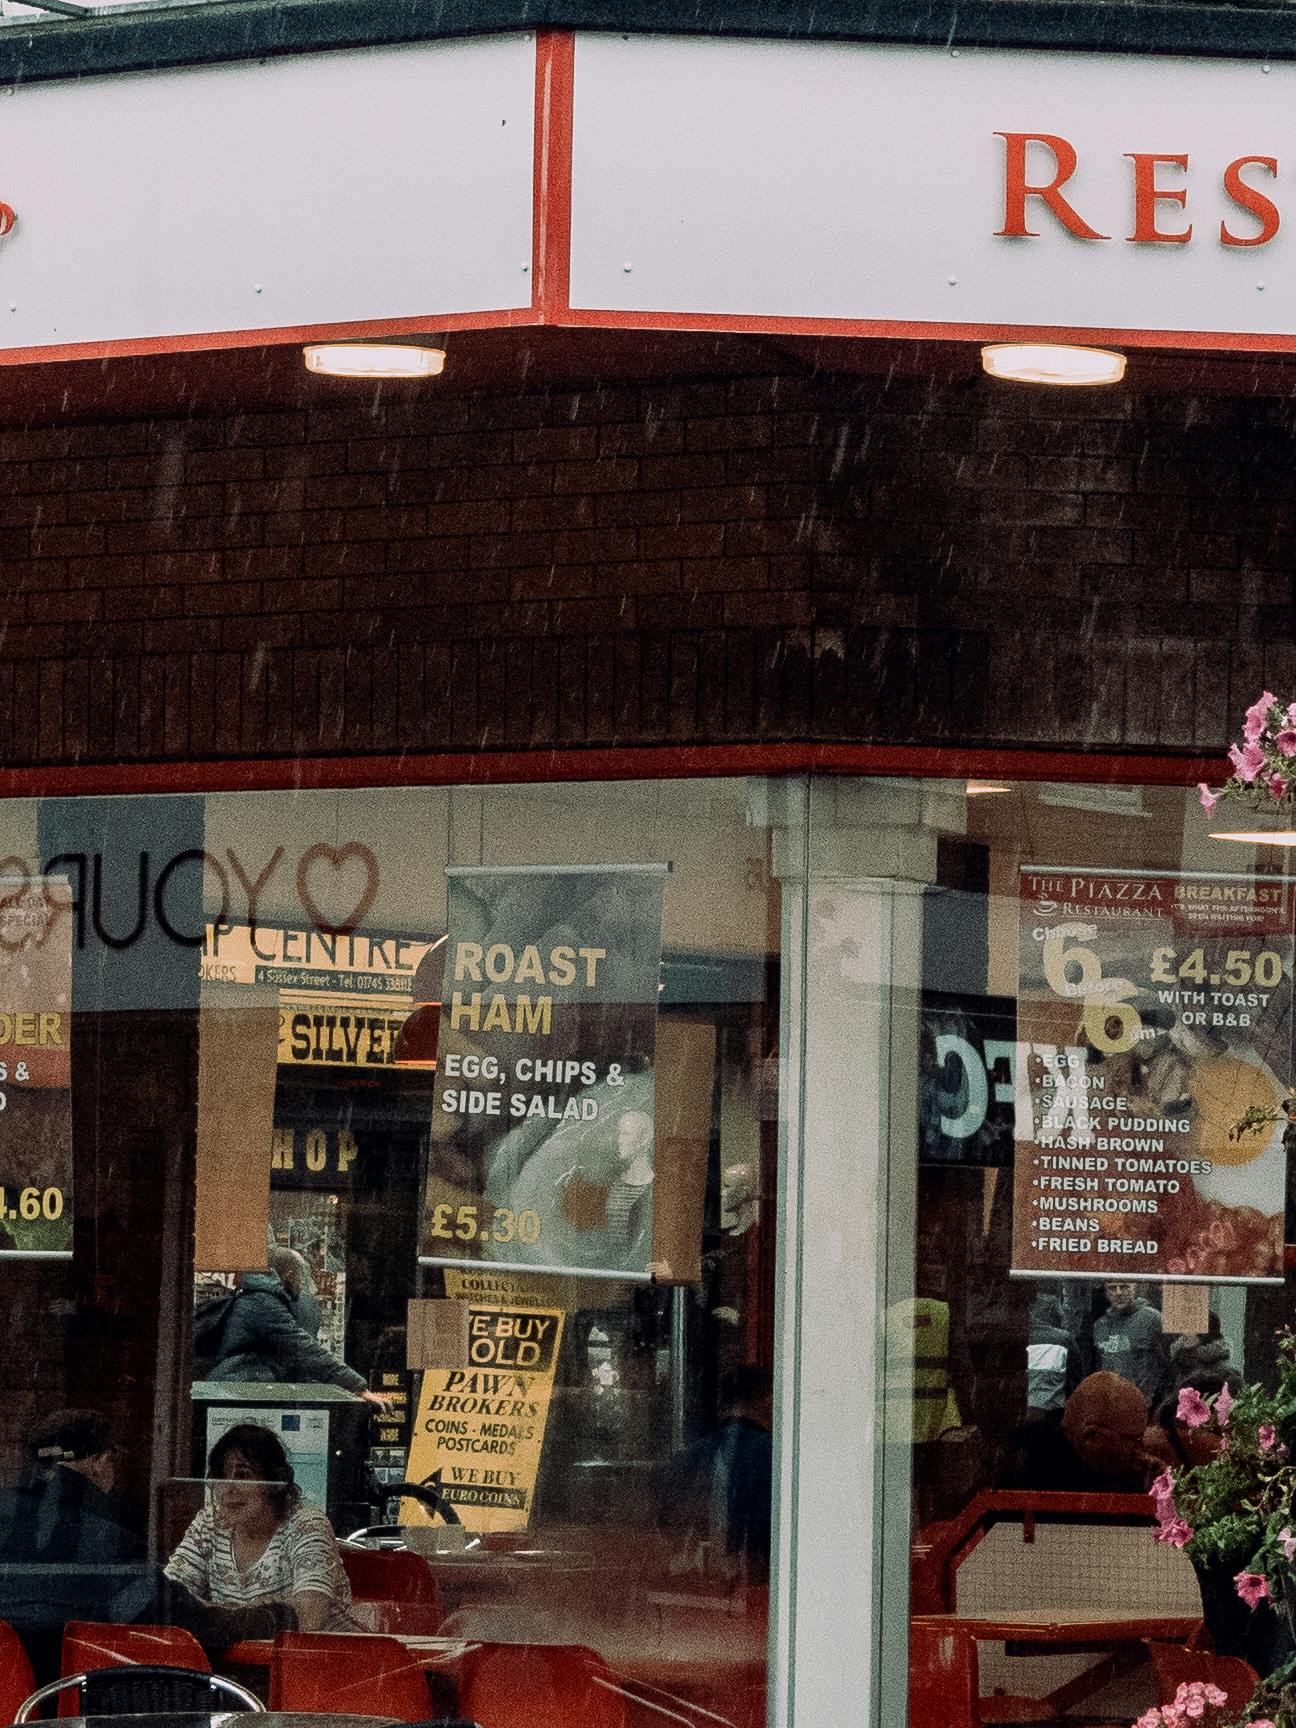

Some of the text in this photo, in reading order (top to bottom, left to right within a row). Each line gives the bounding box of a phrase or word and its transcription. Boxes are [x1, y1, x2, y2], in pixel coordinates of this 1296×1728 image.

[1028, 875, 1163, 900] THE PIAZZA
[1174, 885, 1282, 903] BREAKFAST
[1062, 901, 1165, 918] RESTAURANT
[454, 941, 607, 988] ROAST
[1150, 945, 1283, 988] £4.50
[1158, 990, 1271, 1008] WITH TOAST
[450, 991, 552, 1036] HAM
[1181, 1010, 1253, 1027] OR B&B
[15, 1061, 31, 1082] &
[445, 1053, 625, 1087] EGG, CHIPS &
[1042, 1075, 1105, 1089] BACON
[442, 1089, 599, 1122] SIDE SALAD
[1041, 1095, 1128, 1111] SAUSAGE
[1042, 1116, 1191, 1133] BLACK PUDDING
[271, 1128, 359, 1172] HOP
[1041, 1135, 1164, 1152] HASH BROWN
[1041, 1156, 1213, 1174] TINNED TOMATOES
[1039, 1176, 1180, 1194] FRESH TOMATO
[1039, 1197, 1159, 1214] MUSHROOMS
[430, 1203, 542, 1244] £5.30
[1039, 1217, 1100, 1232] BEANS
[1038, 1237, 1159, 1254] FRIED BREAD
[469, 1314, 550, 1339] E BUY
[470, 1338, 542, 1365] OLD
[442, 1370, 536, 1398] PAWN
[427, 1395, 539, 1418] BROKERS
[425, 1418, 468, 1435] COINS
[479, 1421, 534, 1440] MEDALS
[437, 1437, 516, 1455] POSTCARDS
[451, 1466, 519, 1487] WE BUY
